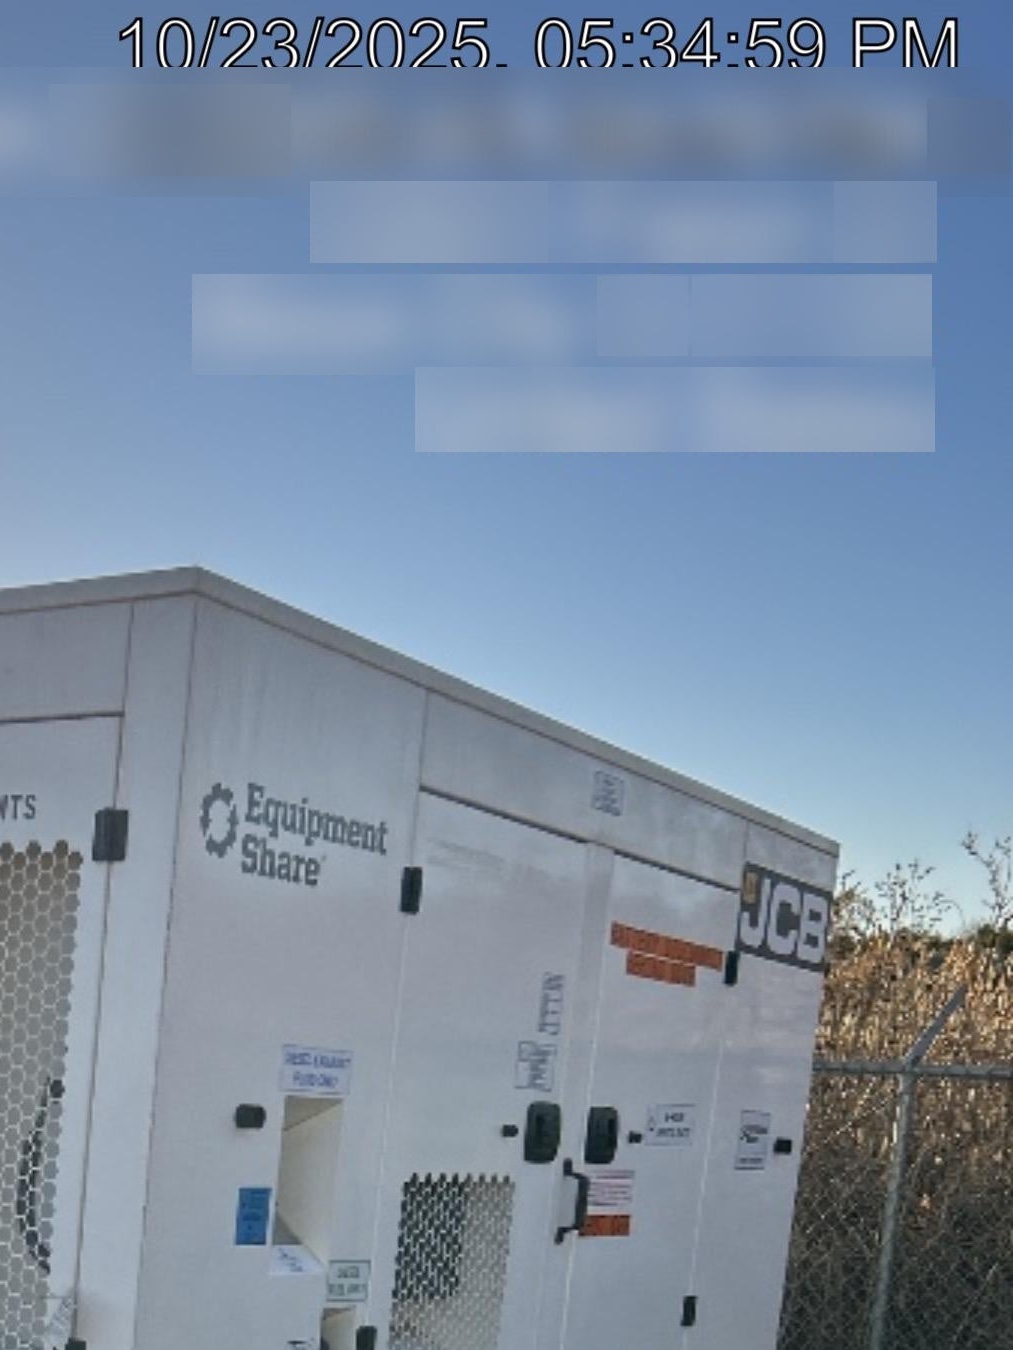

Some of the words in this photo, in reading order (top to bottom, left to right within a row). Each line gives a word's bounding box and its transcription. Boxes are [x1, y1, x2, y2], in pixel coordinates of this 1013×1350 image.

[245, 782, 388, 855] Equipment
[241, 833, 321, 886] Share
[739, 877, 829, 964] JCB
